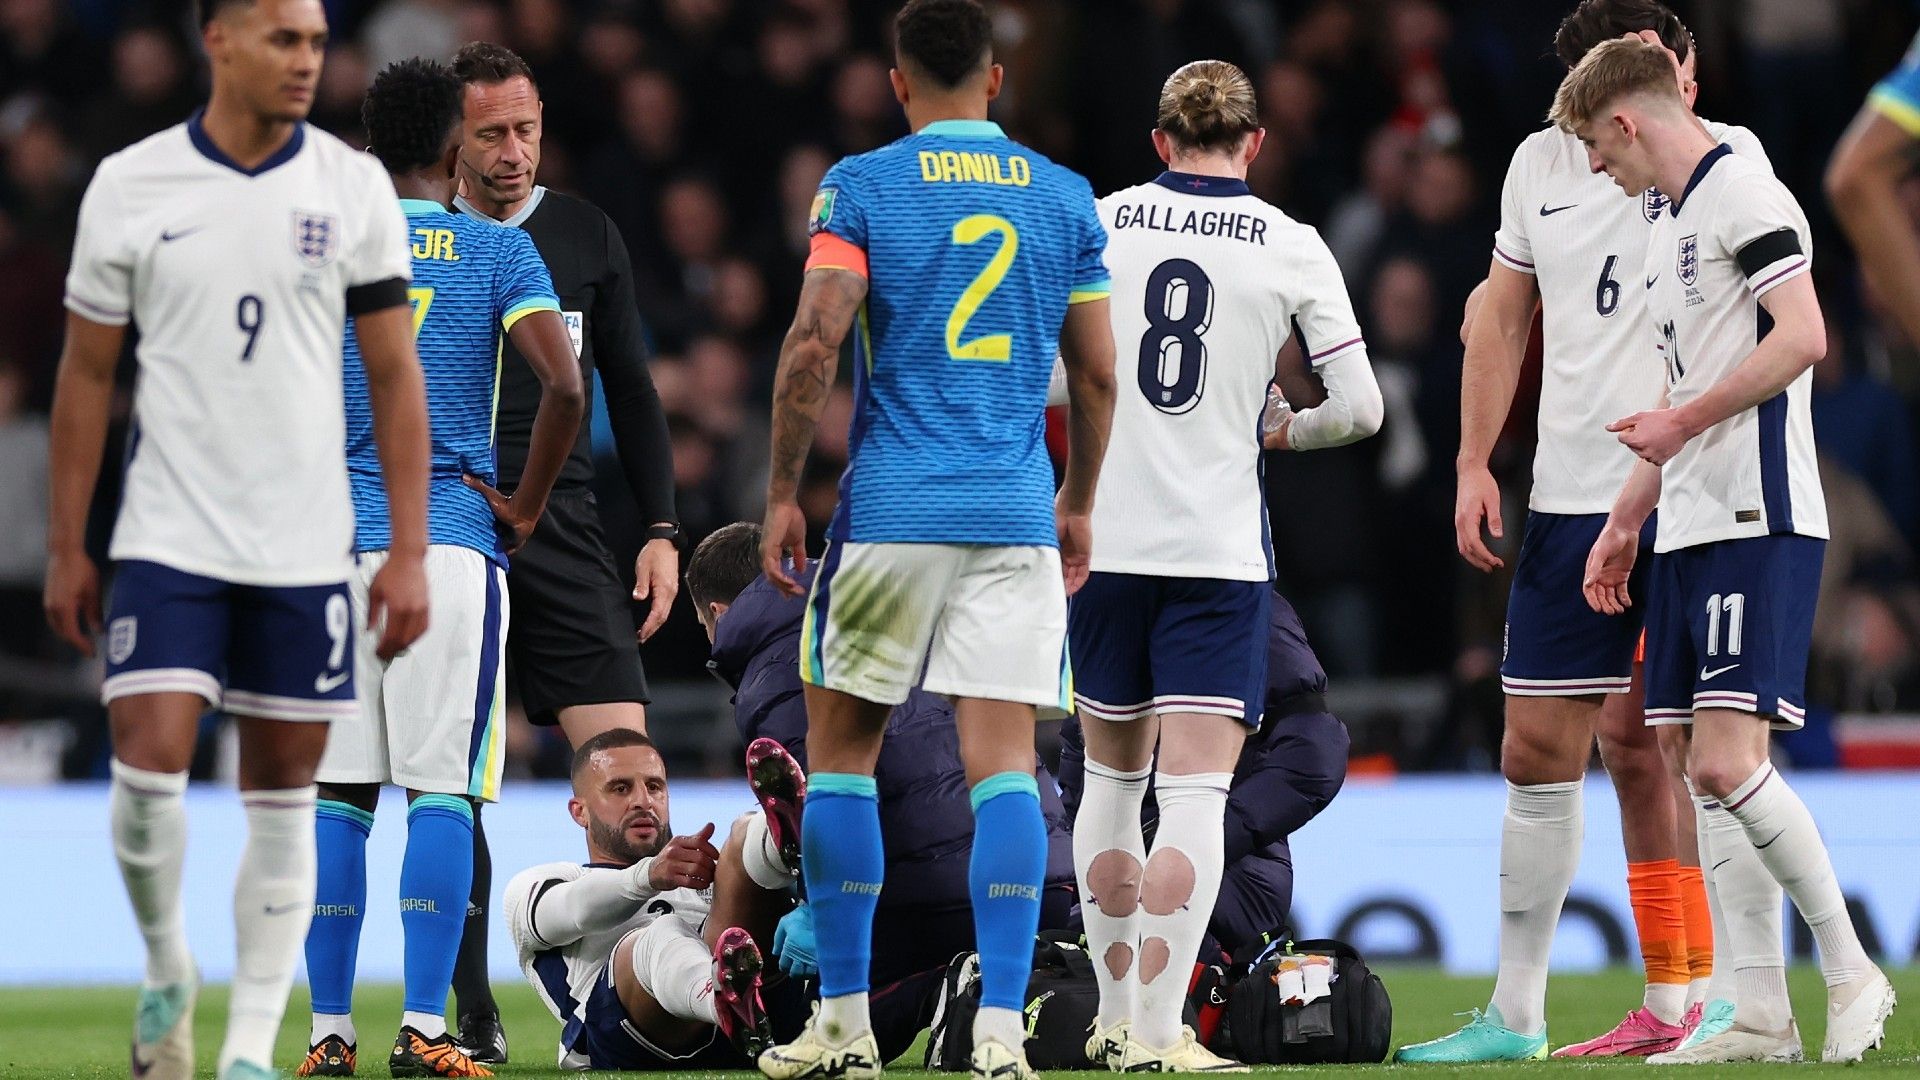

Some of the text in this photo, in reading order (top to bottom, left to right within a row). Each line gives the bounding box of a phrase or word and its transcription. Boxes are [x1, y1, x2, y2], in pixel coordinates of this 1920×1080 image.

[919, 151, 1031, 187] DANILO
[412, 228, 460, 261] JR.
[1114, 204, 1267, 246] GALLAGHER
[945, 214, 1019, 363] 2
[1596, 254, 1622, 318] 6
[237, 294, 265, 362] 9
[564, 315, 580, 329] FA
[1137, 257, 1215, 416] 8
[325, 593, 350, 670] 9
[1706, 593, 1745, 656] 11
